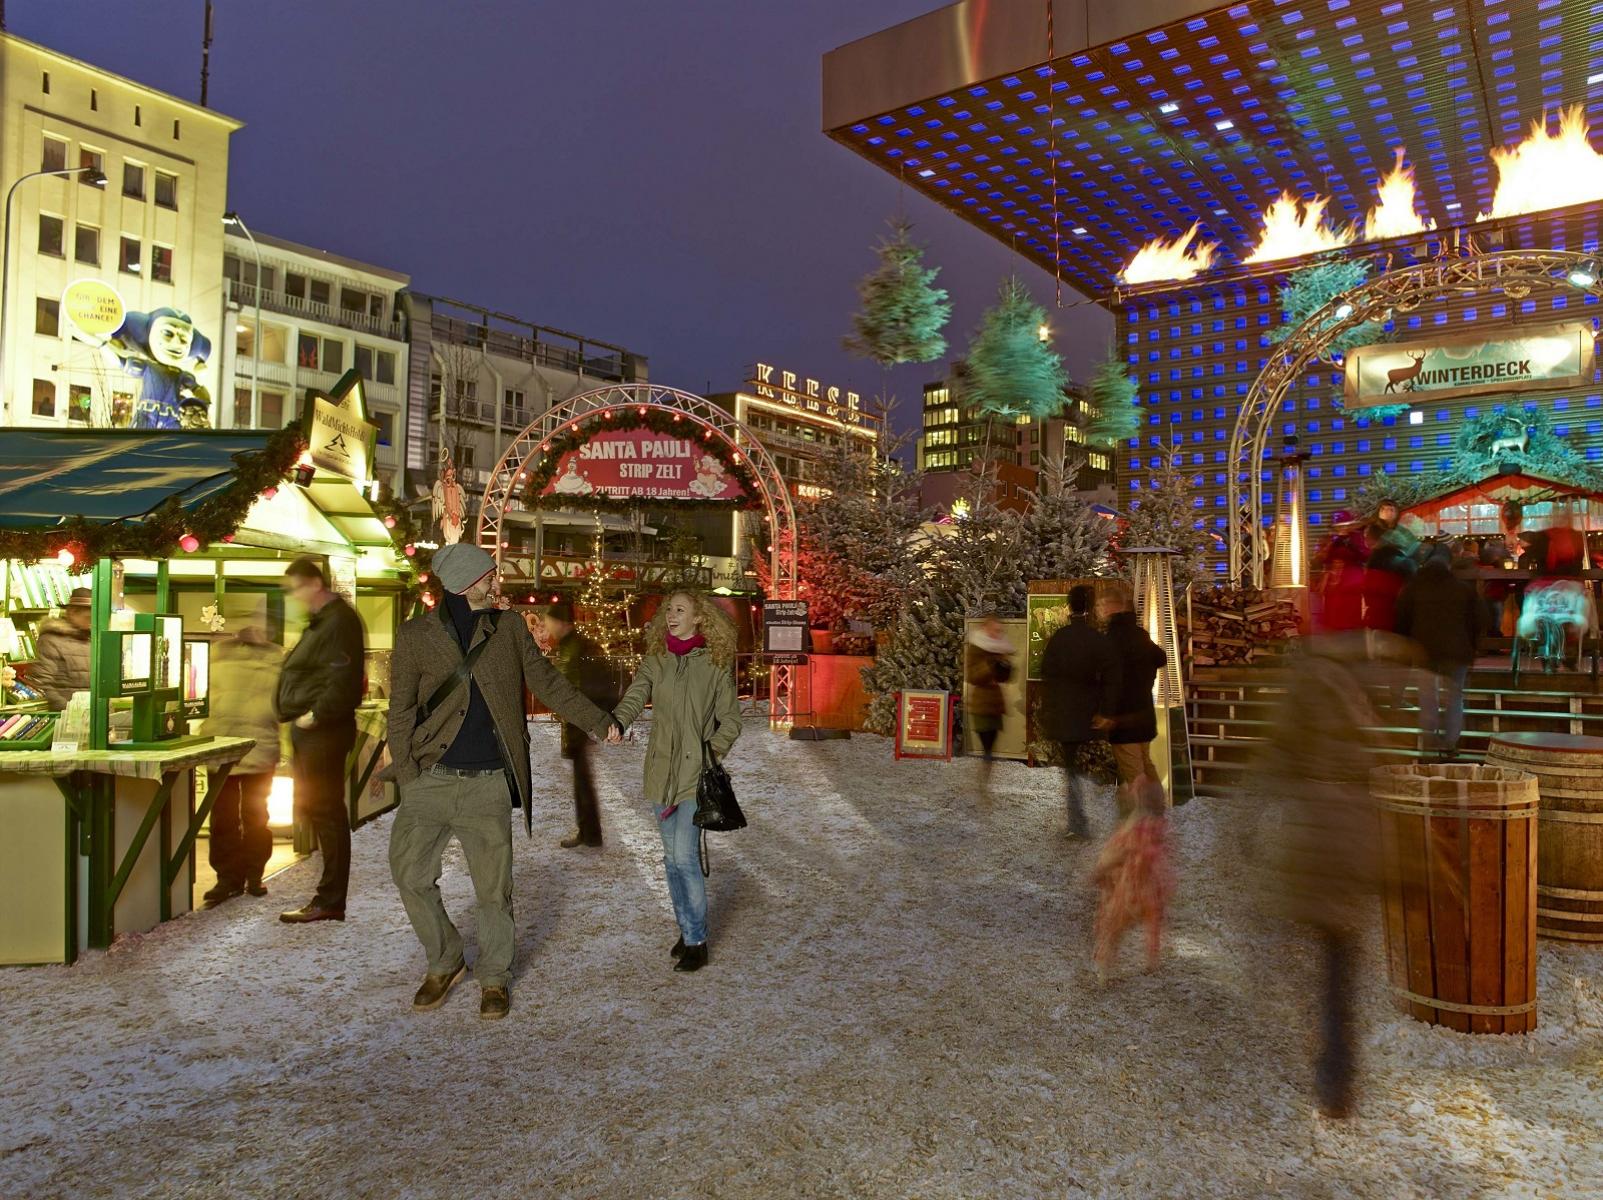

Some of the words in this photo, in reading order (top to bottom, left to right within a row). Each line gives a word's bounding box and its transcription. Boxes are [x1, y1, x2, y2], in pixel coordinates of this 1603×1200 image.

[1417, 359, 1531, 385] WINTERDECK
[757, 363, 860, 423] KEESE
[579, 441, 638, 460] SANTA
[641, 439, 691, 459] PAULI
[619, 463, 653, 478] STRIP
[655, 464, 683, 479] ZELT
[595, 485, 630, 495] ZUTRITT
[631, 486, 644, 495] AB
[646, 487, 657, 496] 18
[658, 486, 690, 497] Jahren!
